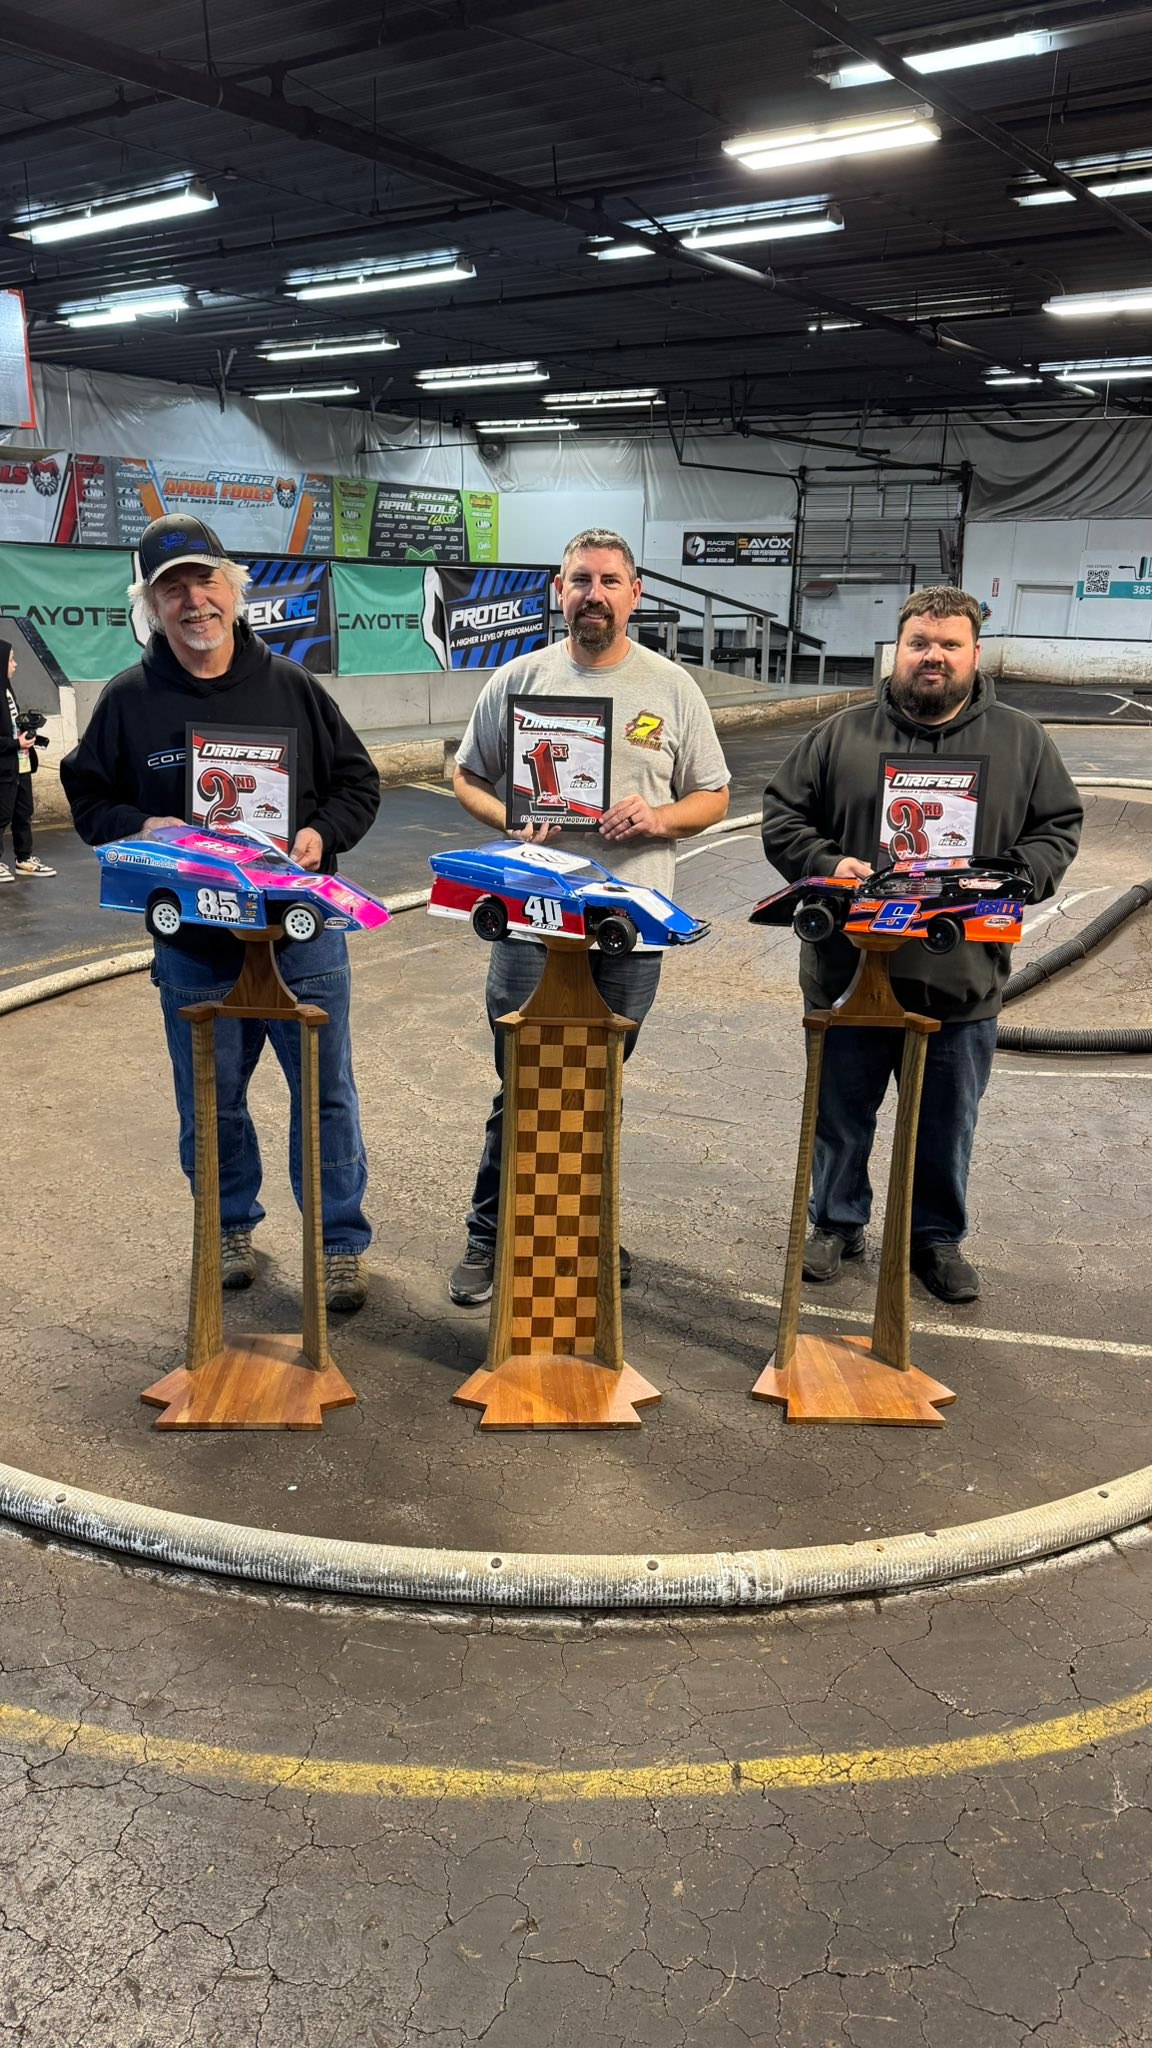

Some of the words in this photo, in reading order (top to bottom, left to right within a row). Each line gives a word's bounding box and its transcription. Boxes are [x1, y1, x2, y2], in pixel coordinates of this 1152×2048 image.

[163, 477, 217, 498] APRIL
[220, 483, 276, 502] FOOLS
[238, 501, 275, 509] Classic
[378, 500, 415, 512] APRIL
[417, 503, 458, 515] FOOLS
[738, 535, 793, 549] SAVÖX
[338, 613, 420, 630] CAYOTE
[456, 636, 479, 647] HIGHER
[480, 632, 496, 642] LEVEL
[497, 630, 504, 638] OF
[504, 623, 544, 637] PERFORMANCE
[535, 815, 565, 824] MIDWEST
[564, 816, 597, 825] MODIFIED
[196, 888, 241, 919] 85
[203, 913, 239, 924] EATON
[525, 896, 563, 927] 40
[530, 921, 561, 931] EATON
